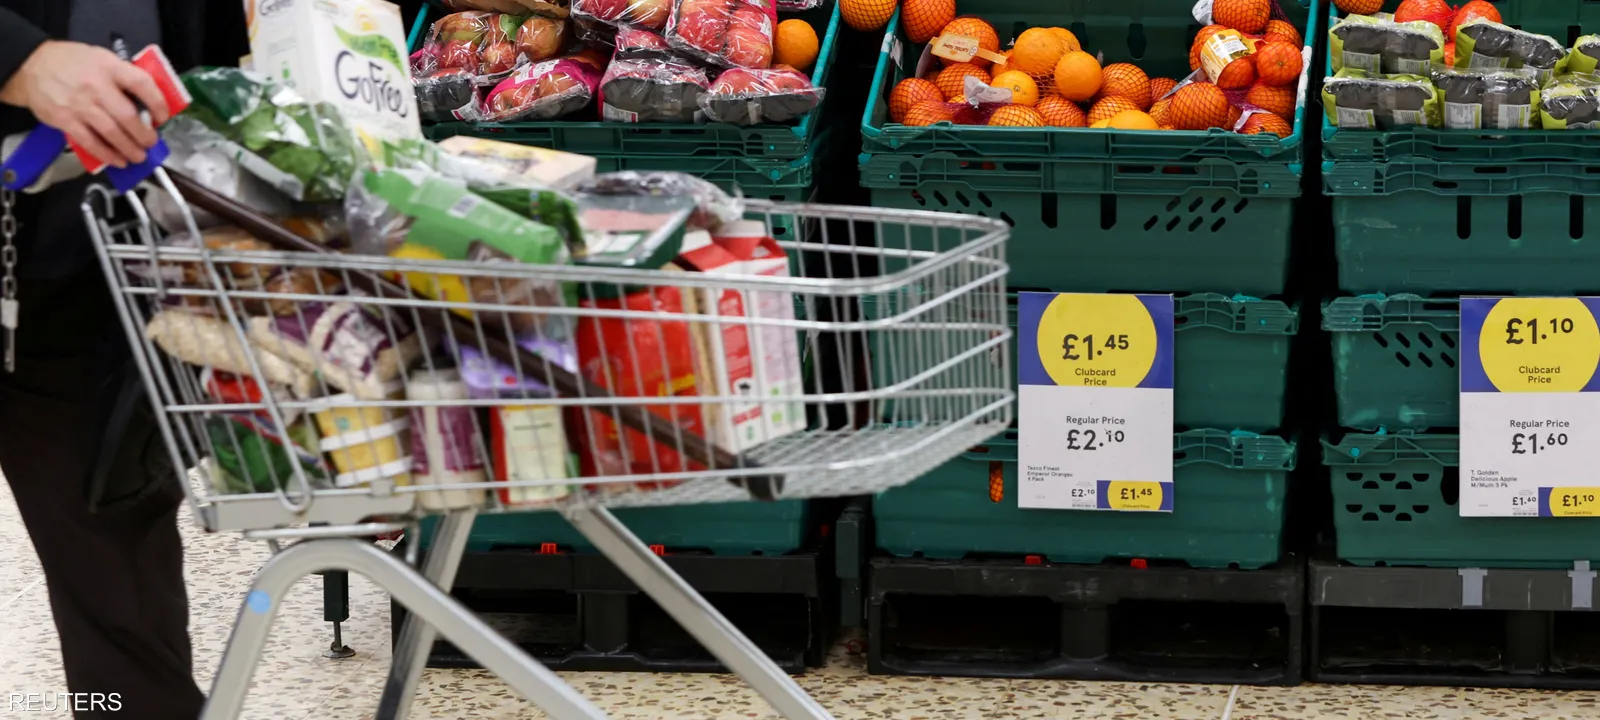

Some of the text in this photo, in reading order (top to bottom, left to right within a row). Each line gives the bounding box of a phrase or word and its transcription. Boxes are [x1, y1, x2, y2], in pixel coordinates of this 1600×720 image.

[335, 50, 408, 118] GoFree
[1506, 318, 1574, 345] £1.10
[1062, 334, 1129, 361] £1.45
[1075, 368, 1116, 377] Clubcard
[1519, 366, 1561, 375] Clubcard
[1084, 377, 1108, 386] Price
[1528, 376, 1552, 384] Price
[1066, 416, 1125, 426] Regular Price
[1510, 419, 1570, 430] Regular Price
[1067, 429, 1125, 451] £2.10
[1511, 433, 1568, 455] £1.60
[1071, 488, 1095, 498] £2.10
[1120, 487, 1153, 500] £1.45
[1512, 496, 1537, 506] £1.60
[1562, 494, 1595, 507] £1.10
